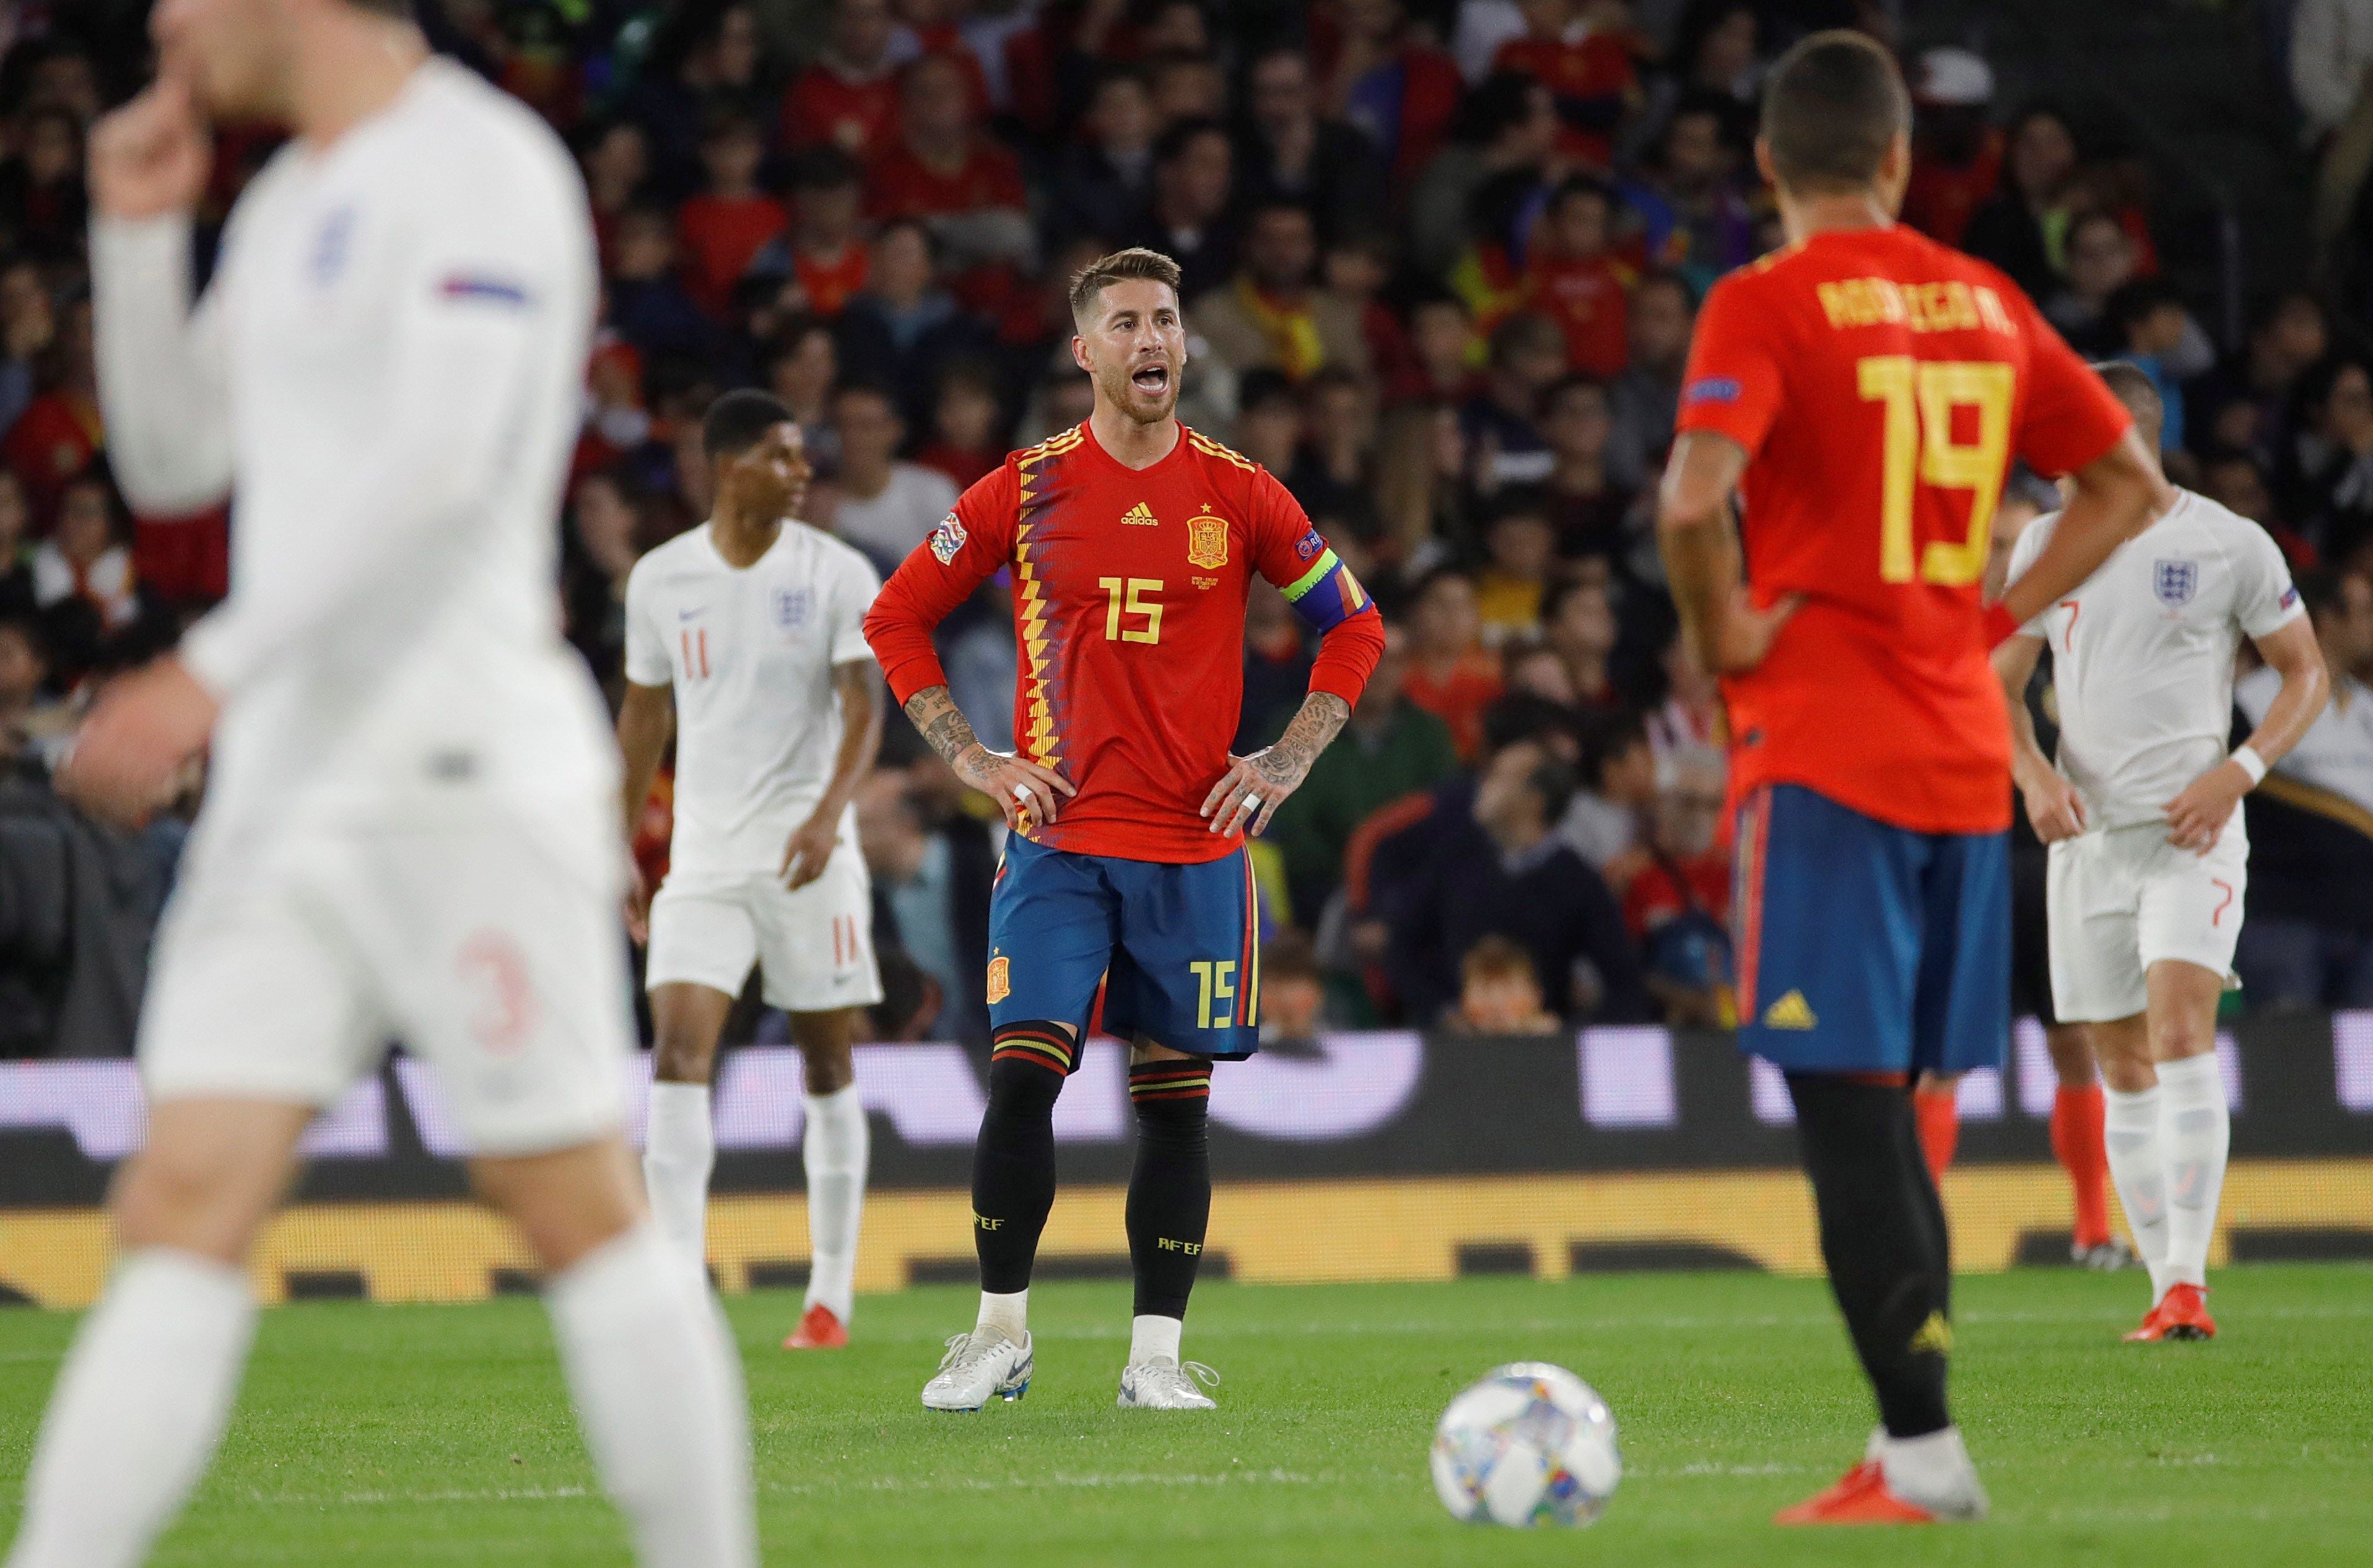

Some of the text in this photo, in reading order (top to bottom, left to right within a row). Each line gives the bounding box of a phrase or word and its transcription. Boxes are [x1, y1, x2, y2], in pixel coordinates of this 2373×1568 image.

[1857, 354, 2017, 587] 19
[1121, 516, 1159, 526] adidas
[1099, 577, 1164, 645] 15
[2060, 601, 2079, 653] 7
[682, 628, 710, 680] 11
[2212, 878, 2233, 927] 7
[834, 915, 857, 965] 11
[454, 927, 545, 1056] 3
[1190, 960, 1235, 1029] 15
[1158, 1237, 1201, 1255] RFEF
